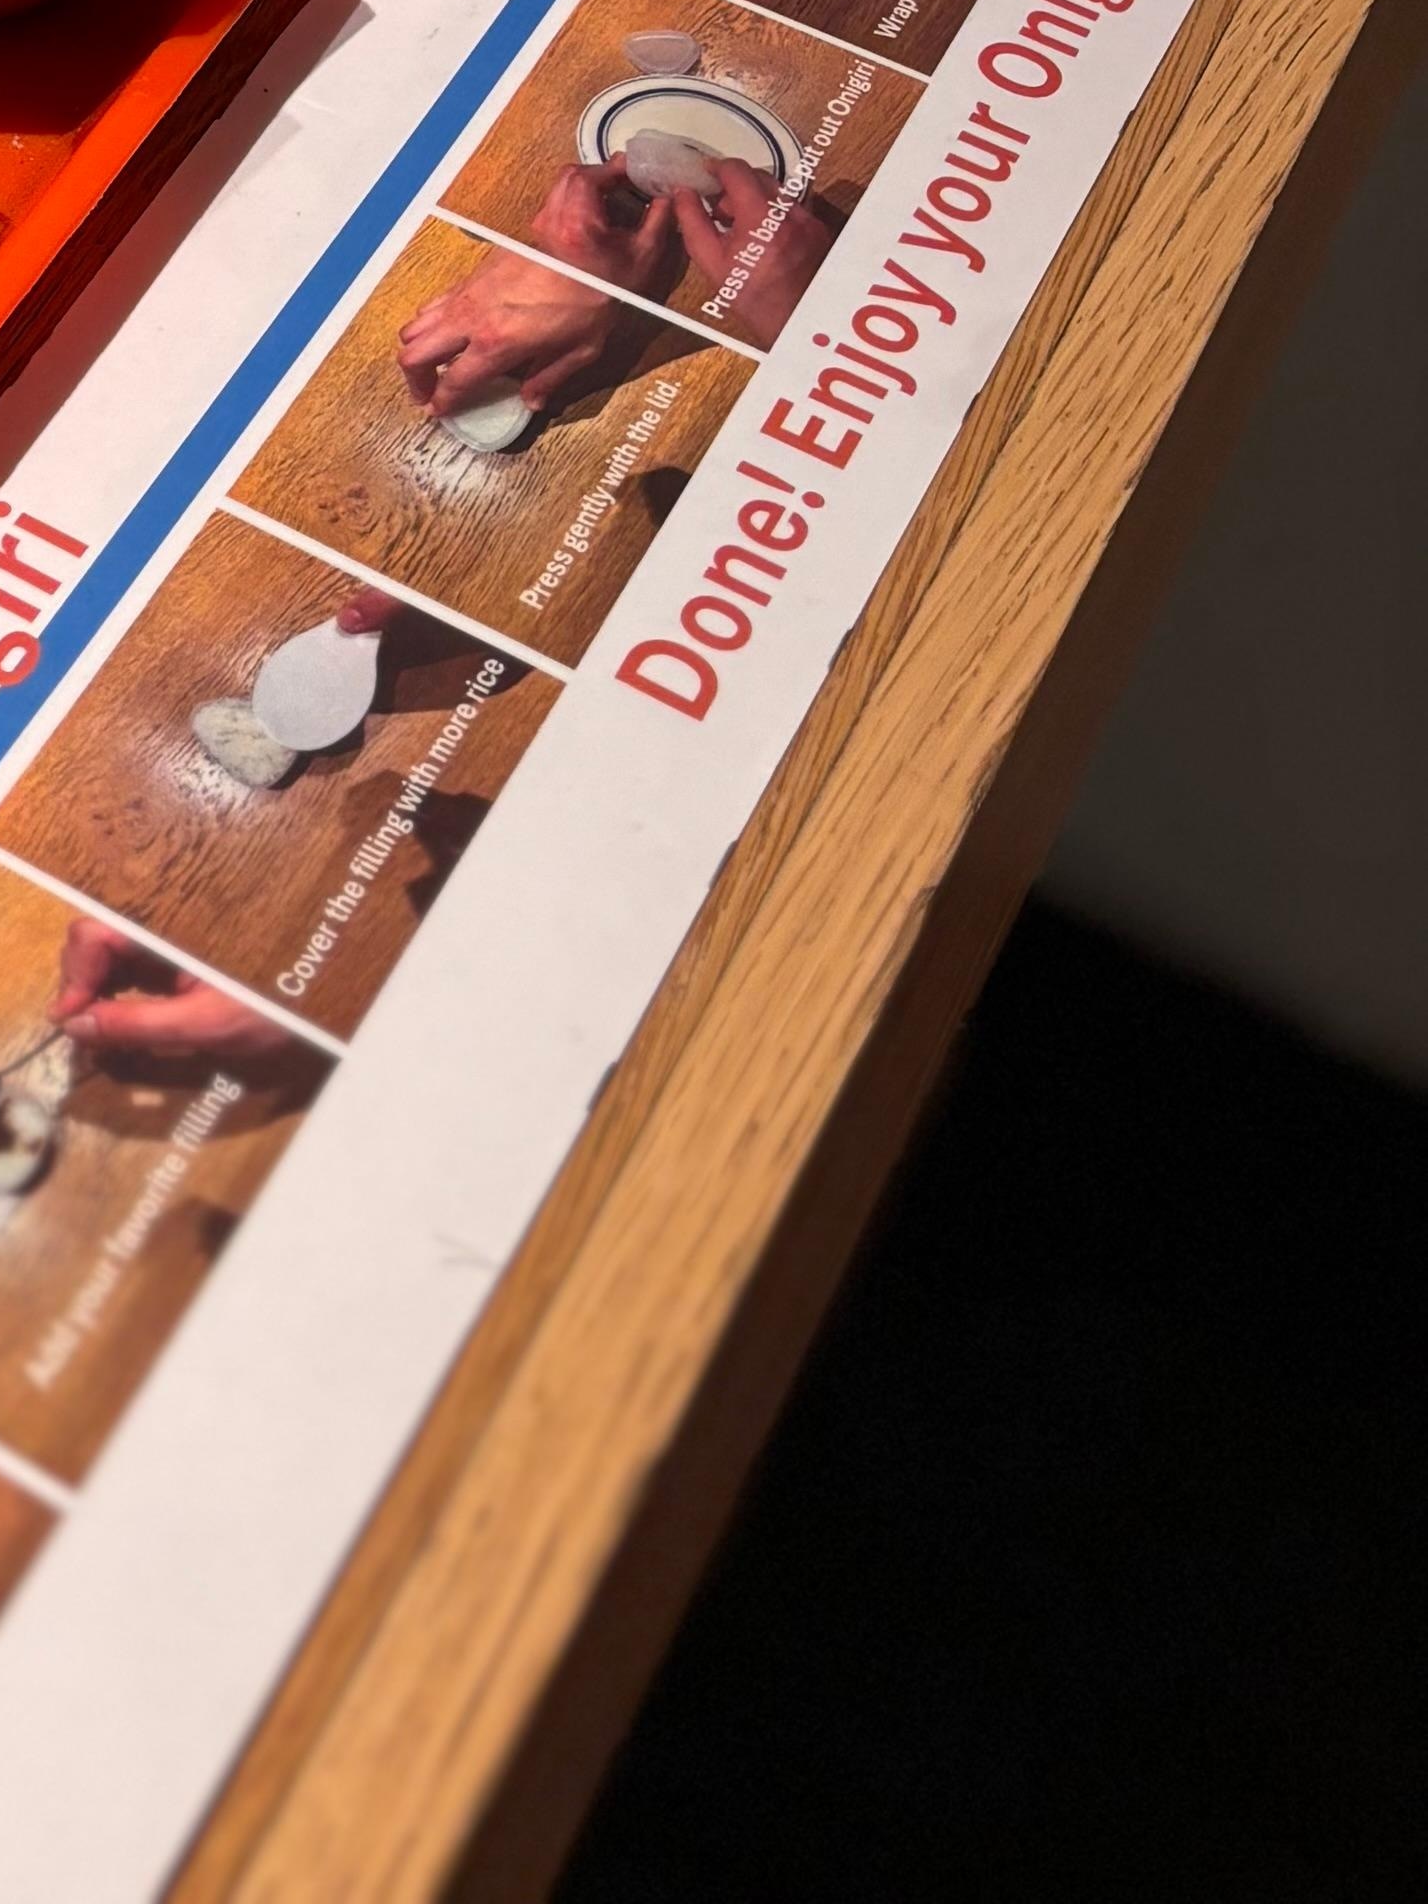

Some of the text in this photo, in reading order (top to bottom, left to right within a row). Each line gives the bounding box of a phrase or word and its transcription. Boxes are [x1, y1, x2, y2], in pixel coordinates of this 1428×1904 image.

[700, 59, 877, 319] Press its back to put out Onigiri
[519, 379, 682, 611] Press gently with the lid.
[614, 460, 827, 722] Done!
[760, 259, 957, 471] Enjoy
[899, 101, 1032, 274] your
[275, 657, 506, 998] Cover the filling with more rice
[103, 1153, 188, 1260] favorite
[170, 1072, 244, 1153] filling
